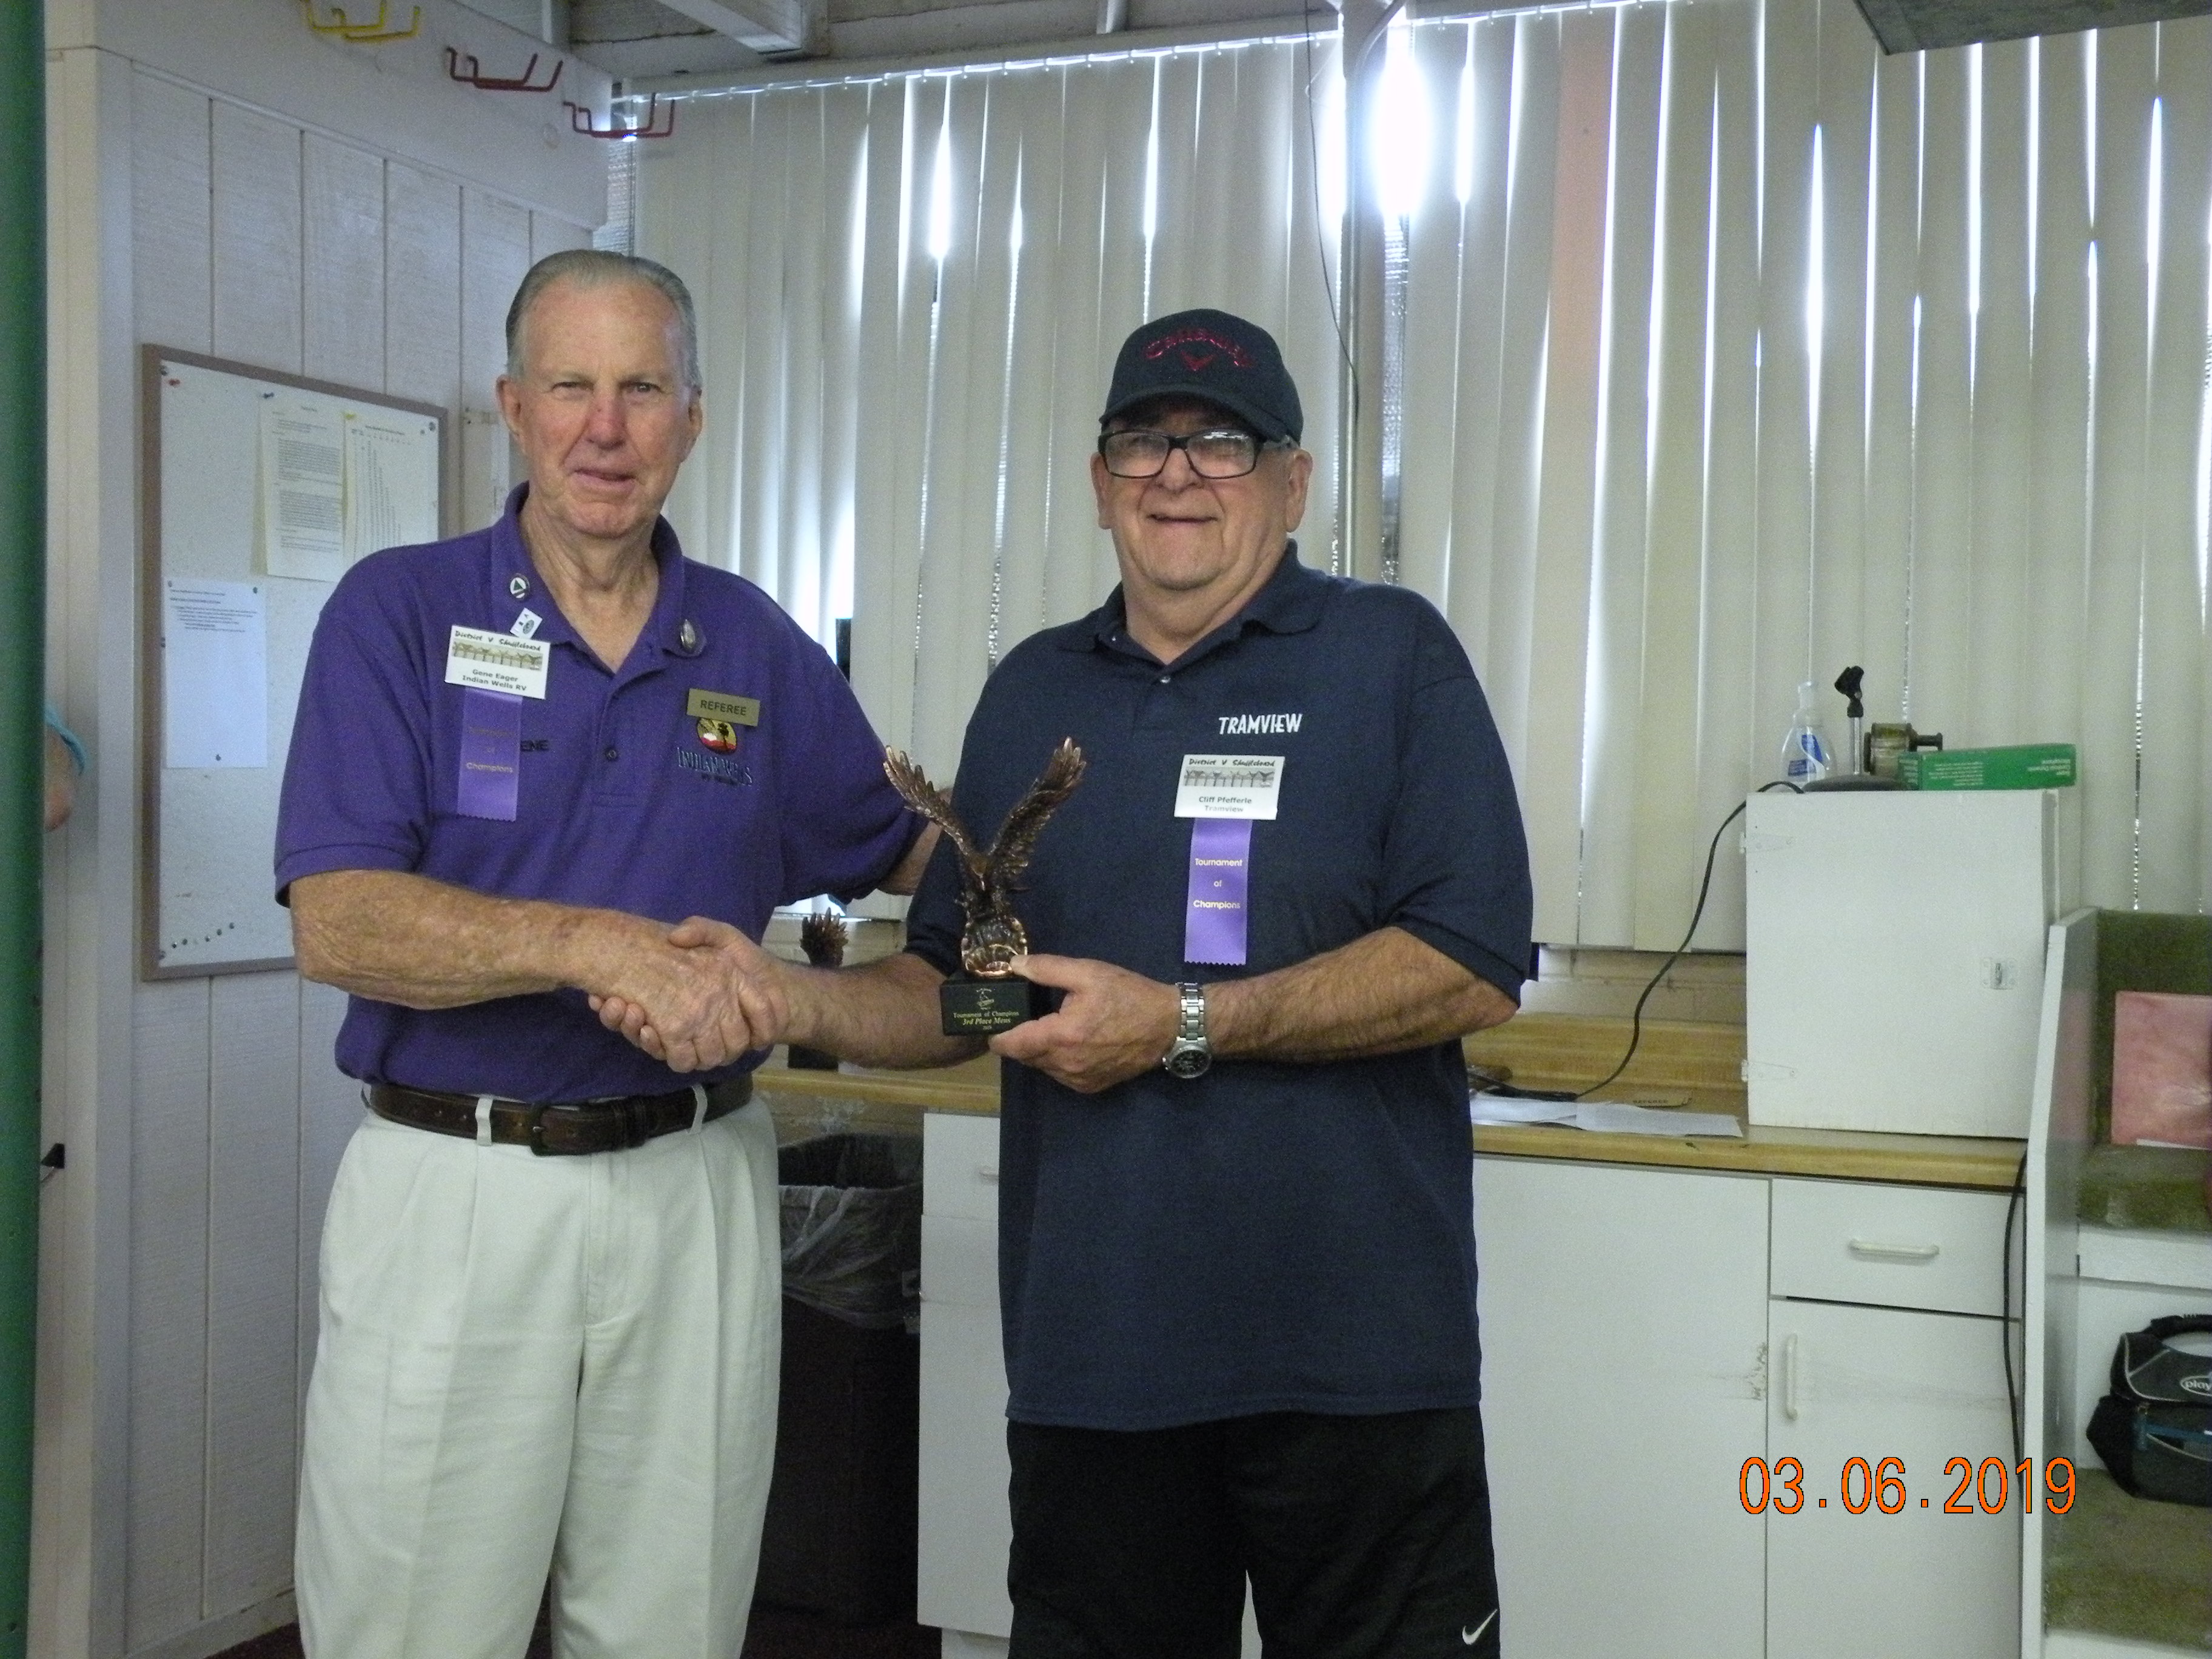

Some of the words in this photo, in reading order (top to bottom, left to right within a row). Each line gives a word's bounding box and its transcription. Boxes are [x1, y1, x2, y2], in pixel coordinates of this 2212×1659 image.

[455, 631, 483, 641] District
[472, 669, 493, 677] Gene
[495, 673, 518, 683] Eager
[462, 675, 489, 685] Indian
[492, 680, 514, 689] Wells
[700, 700, 746, 716] REFEREE
[1218, 713, 1302, 735] TRAMVIEW
[520, 740, 548, 752] ENE
[677, 747, 719, 774] INDIAN
[466, 762, 513, 773] Champions
[1195, 858, 1242, 867] Tournament
[1213, 879, 1222, 888] of
[1193, 899, 1241, 910] Champions
[2184, 1380, 2212, 1391] play
